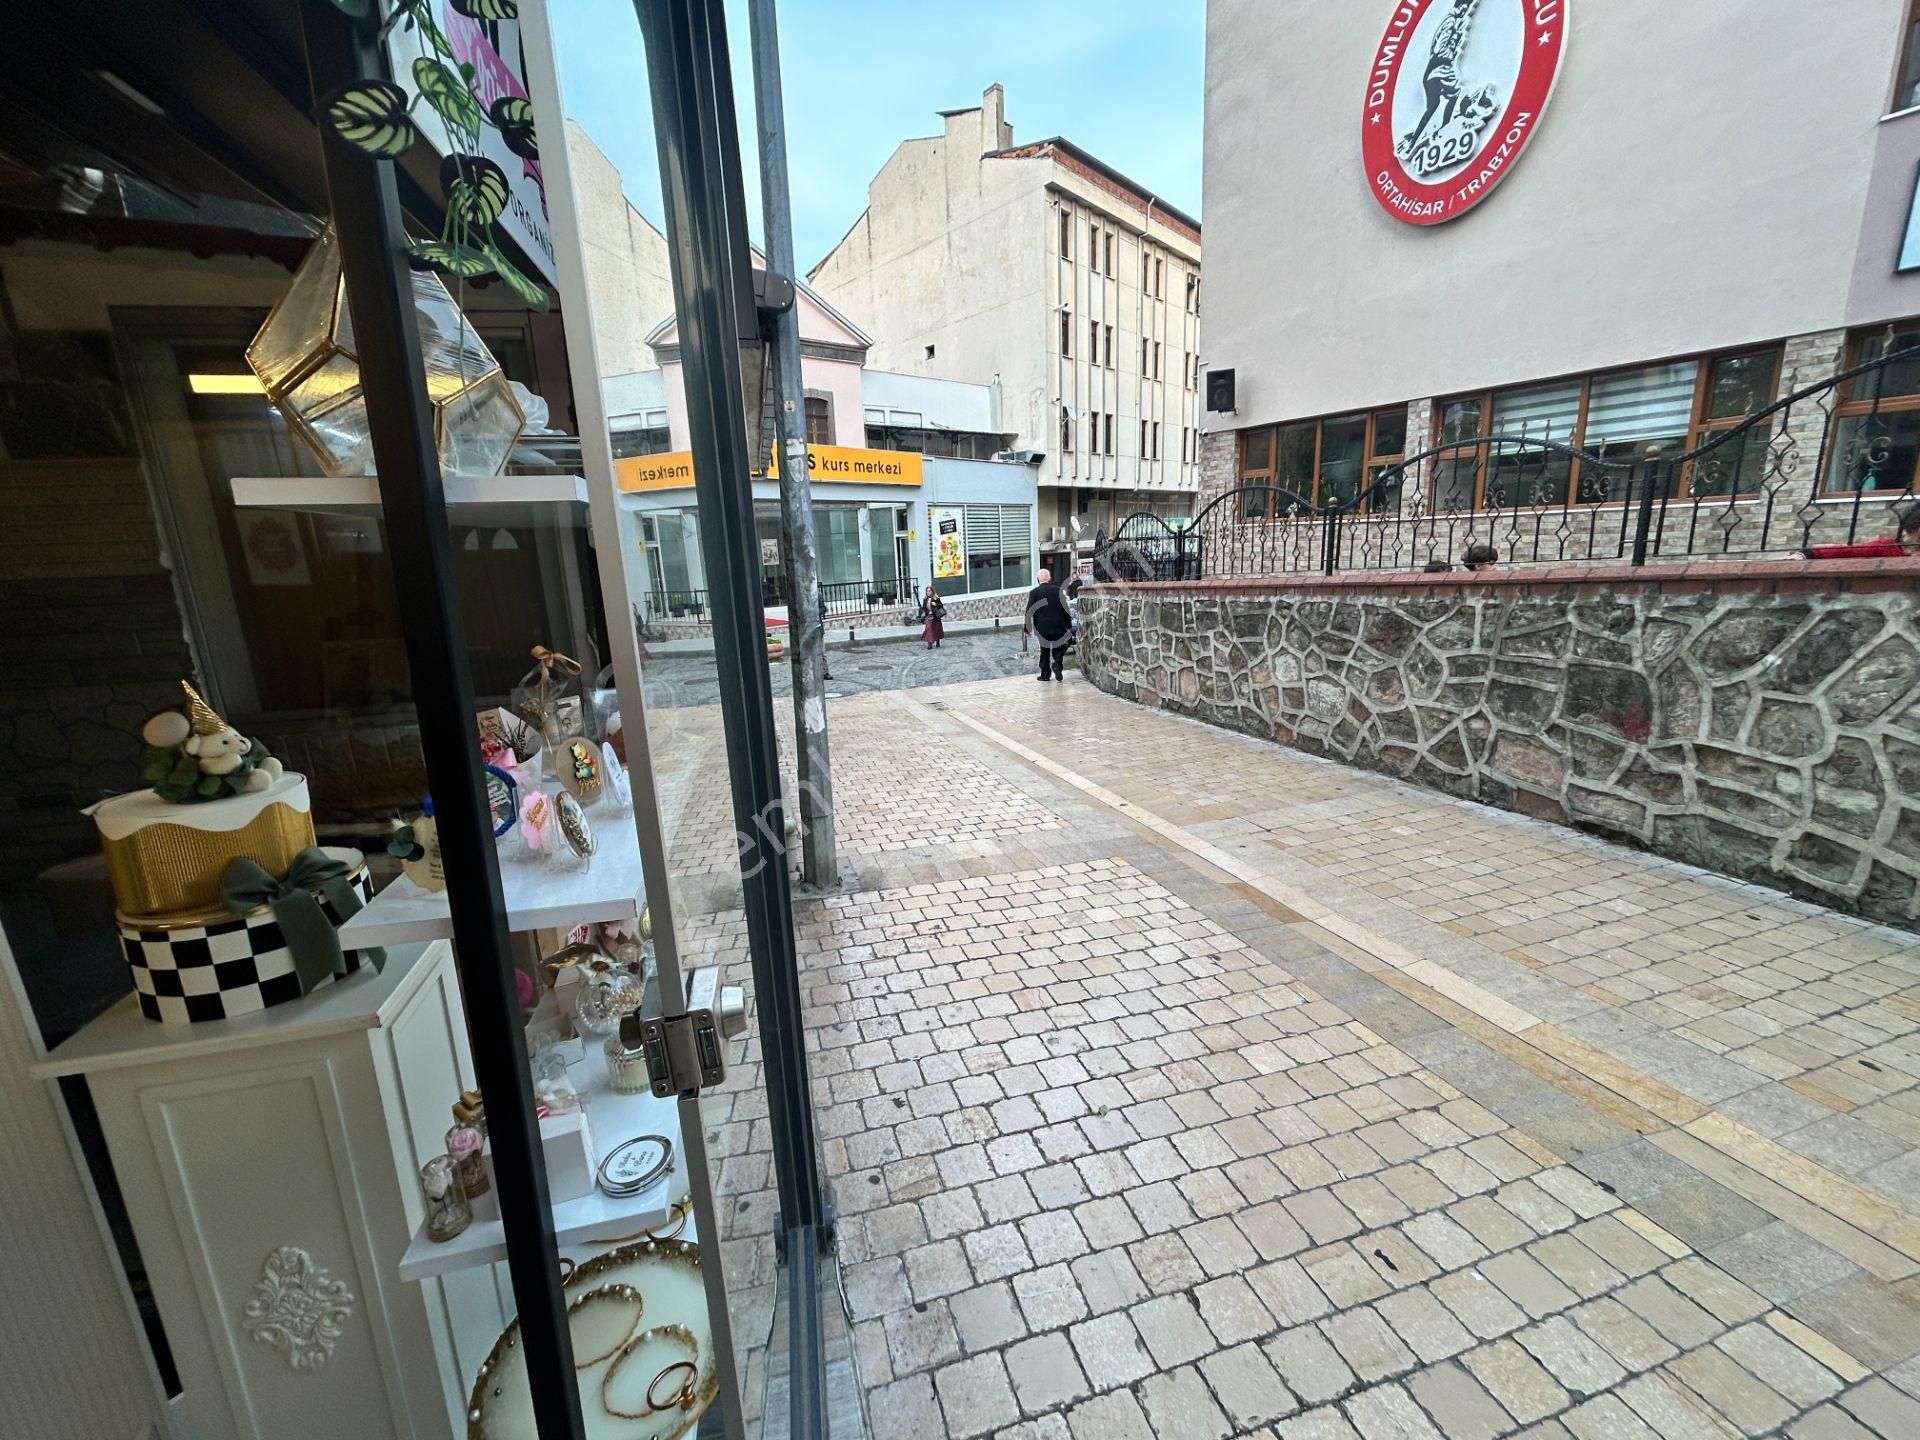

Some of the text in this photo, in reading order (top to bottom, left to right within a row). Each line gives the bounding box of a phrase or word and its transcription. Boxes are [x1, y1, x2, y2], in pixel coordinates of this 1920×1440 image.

[1376, 171, 1443, 216] ORTAHİSAR
[1457, 111, 1532, 201] TRABZON
[1415, 132, 1475, 173] 1929
[822, 456, 849, 472] kurs
[854, 461, 902, 475] merkezi
